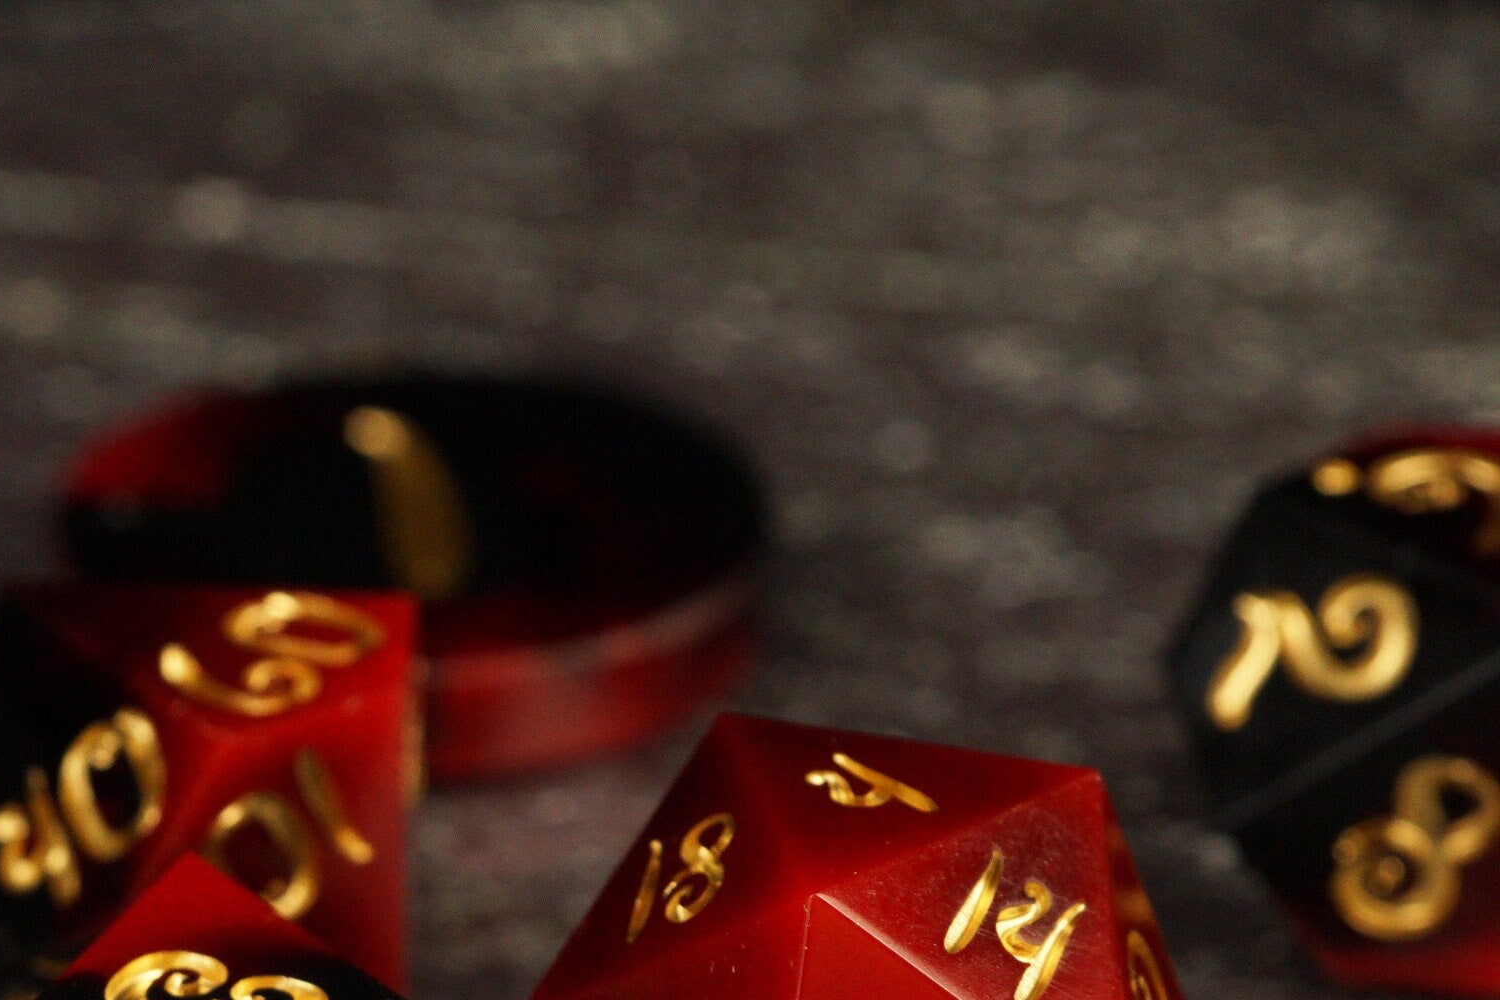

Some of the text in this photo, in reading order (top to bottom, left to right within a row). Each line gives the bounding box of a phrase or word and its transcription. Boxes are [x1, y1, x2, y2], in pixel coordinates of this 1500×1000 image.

[1206, 573, 1419, 732] 2
[805, 750, 938, 813] 4
[1330, 756, 1500, 940] 8
[626, 812, 735, 943] 18
